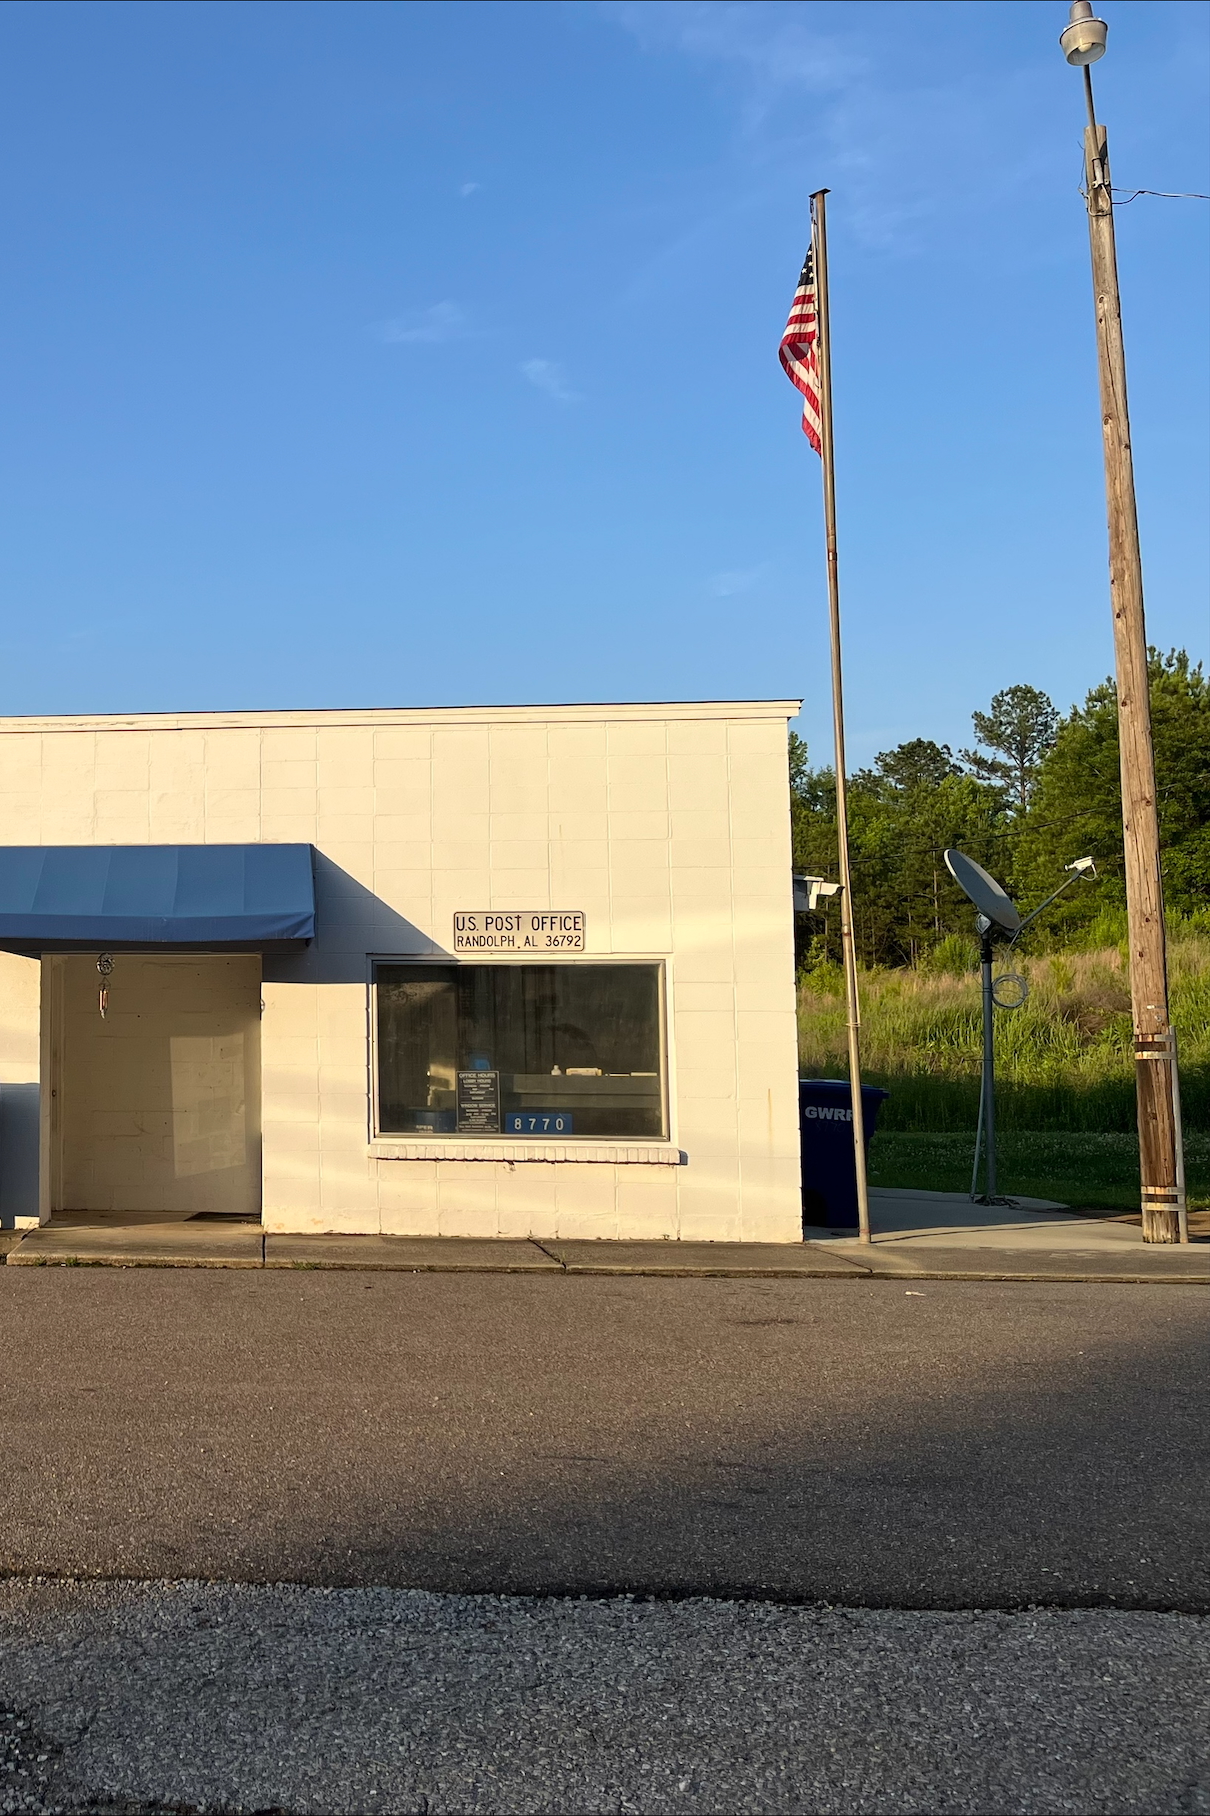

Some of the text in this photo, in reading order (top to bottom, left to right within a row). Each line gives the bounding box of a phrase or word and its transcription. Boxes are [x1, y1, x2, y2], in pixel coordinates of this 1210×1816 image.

[456, 915, 582, 931] U.S. POST OFFICE
[524, 935, 538, 947] AL
[545, 935, 581, 947] 36792
[514, 1118, 564, 1130] 8770
